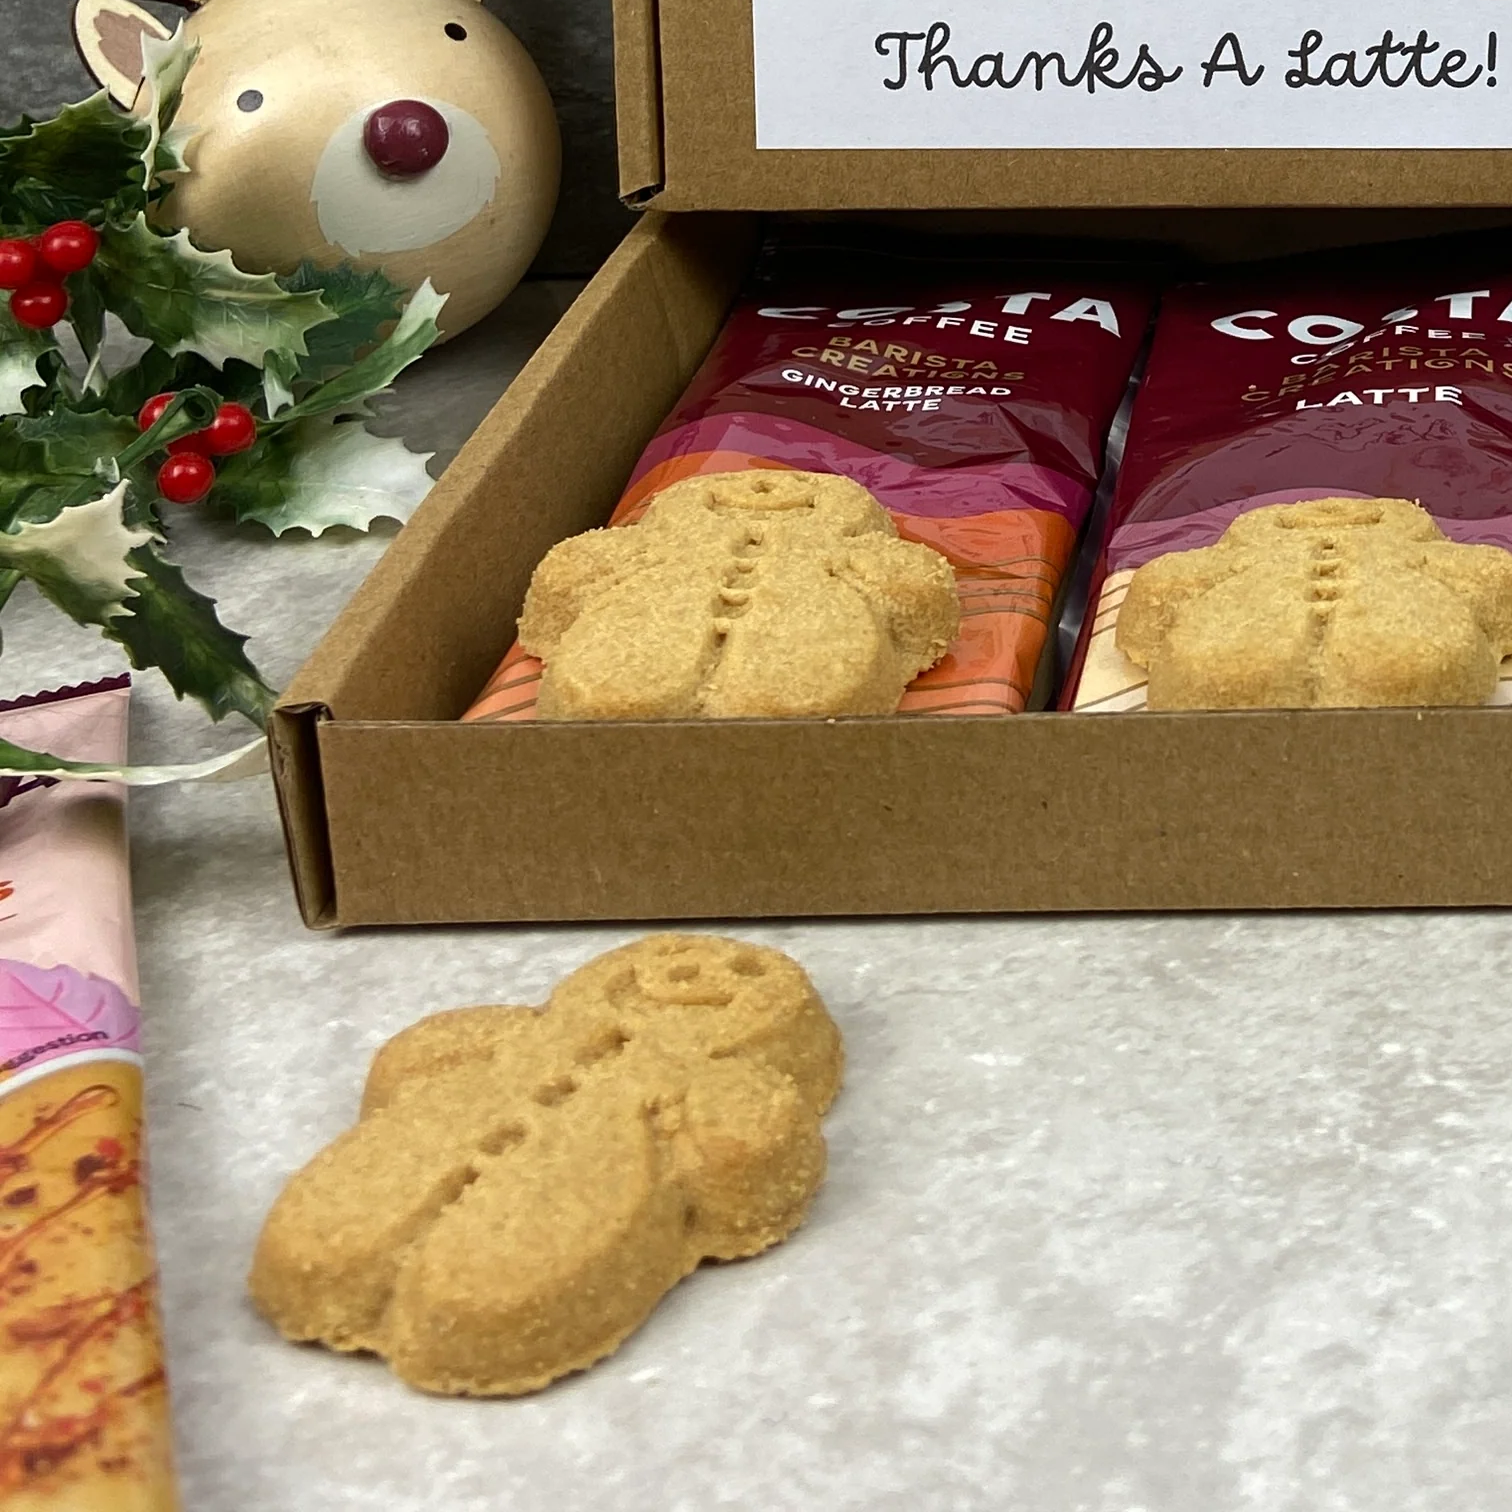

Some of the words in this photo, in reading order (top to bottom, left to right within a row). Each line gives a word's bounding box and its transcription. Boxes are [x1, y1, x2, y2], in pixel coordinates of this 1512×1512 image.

[873, 20, 1184, 94] Thanks
[1199, 31, 1265, 88] A
[1283, 28, 1497, 89] Latte!
[826, 315, 1033, 345] COFFEE
[791, 346, 1025, 381] CREATIONS
[828, 336, 998, 371] BARISTA
[1282, 346, 1489, 386] BARISTA
[781, 368, 1012, 399] GINGERBREAD
[1295, 385, 1463, 411] LATTE
[839, 397, 942, 413] LATTE
